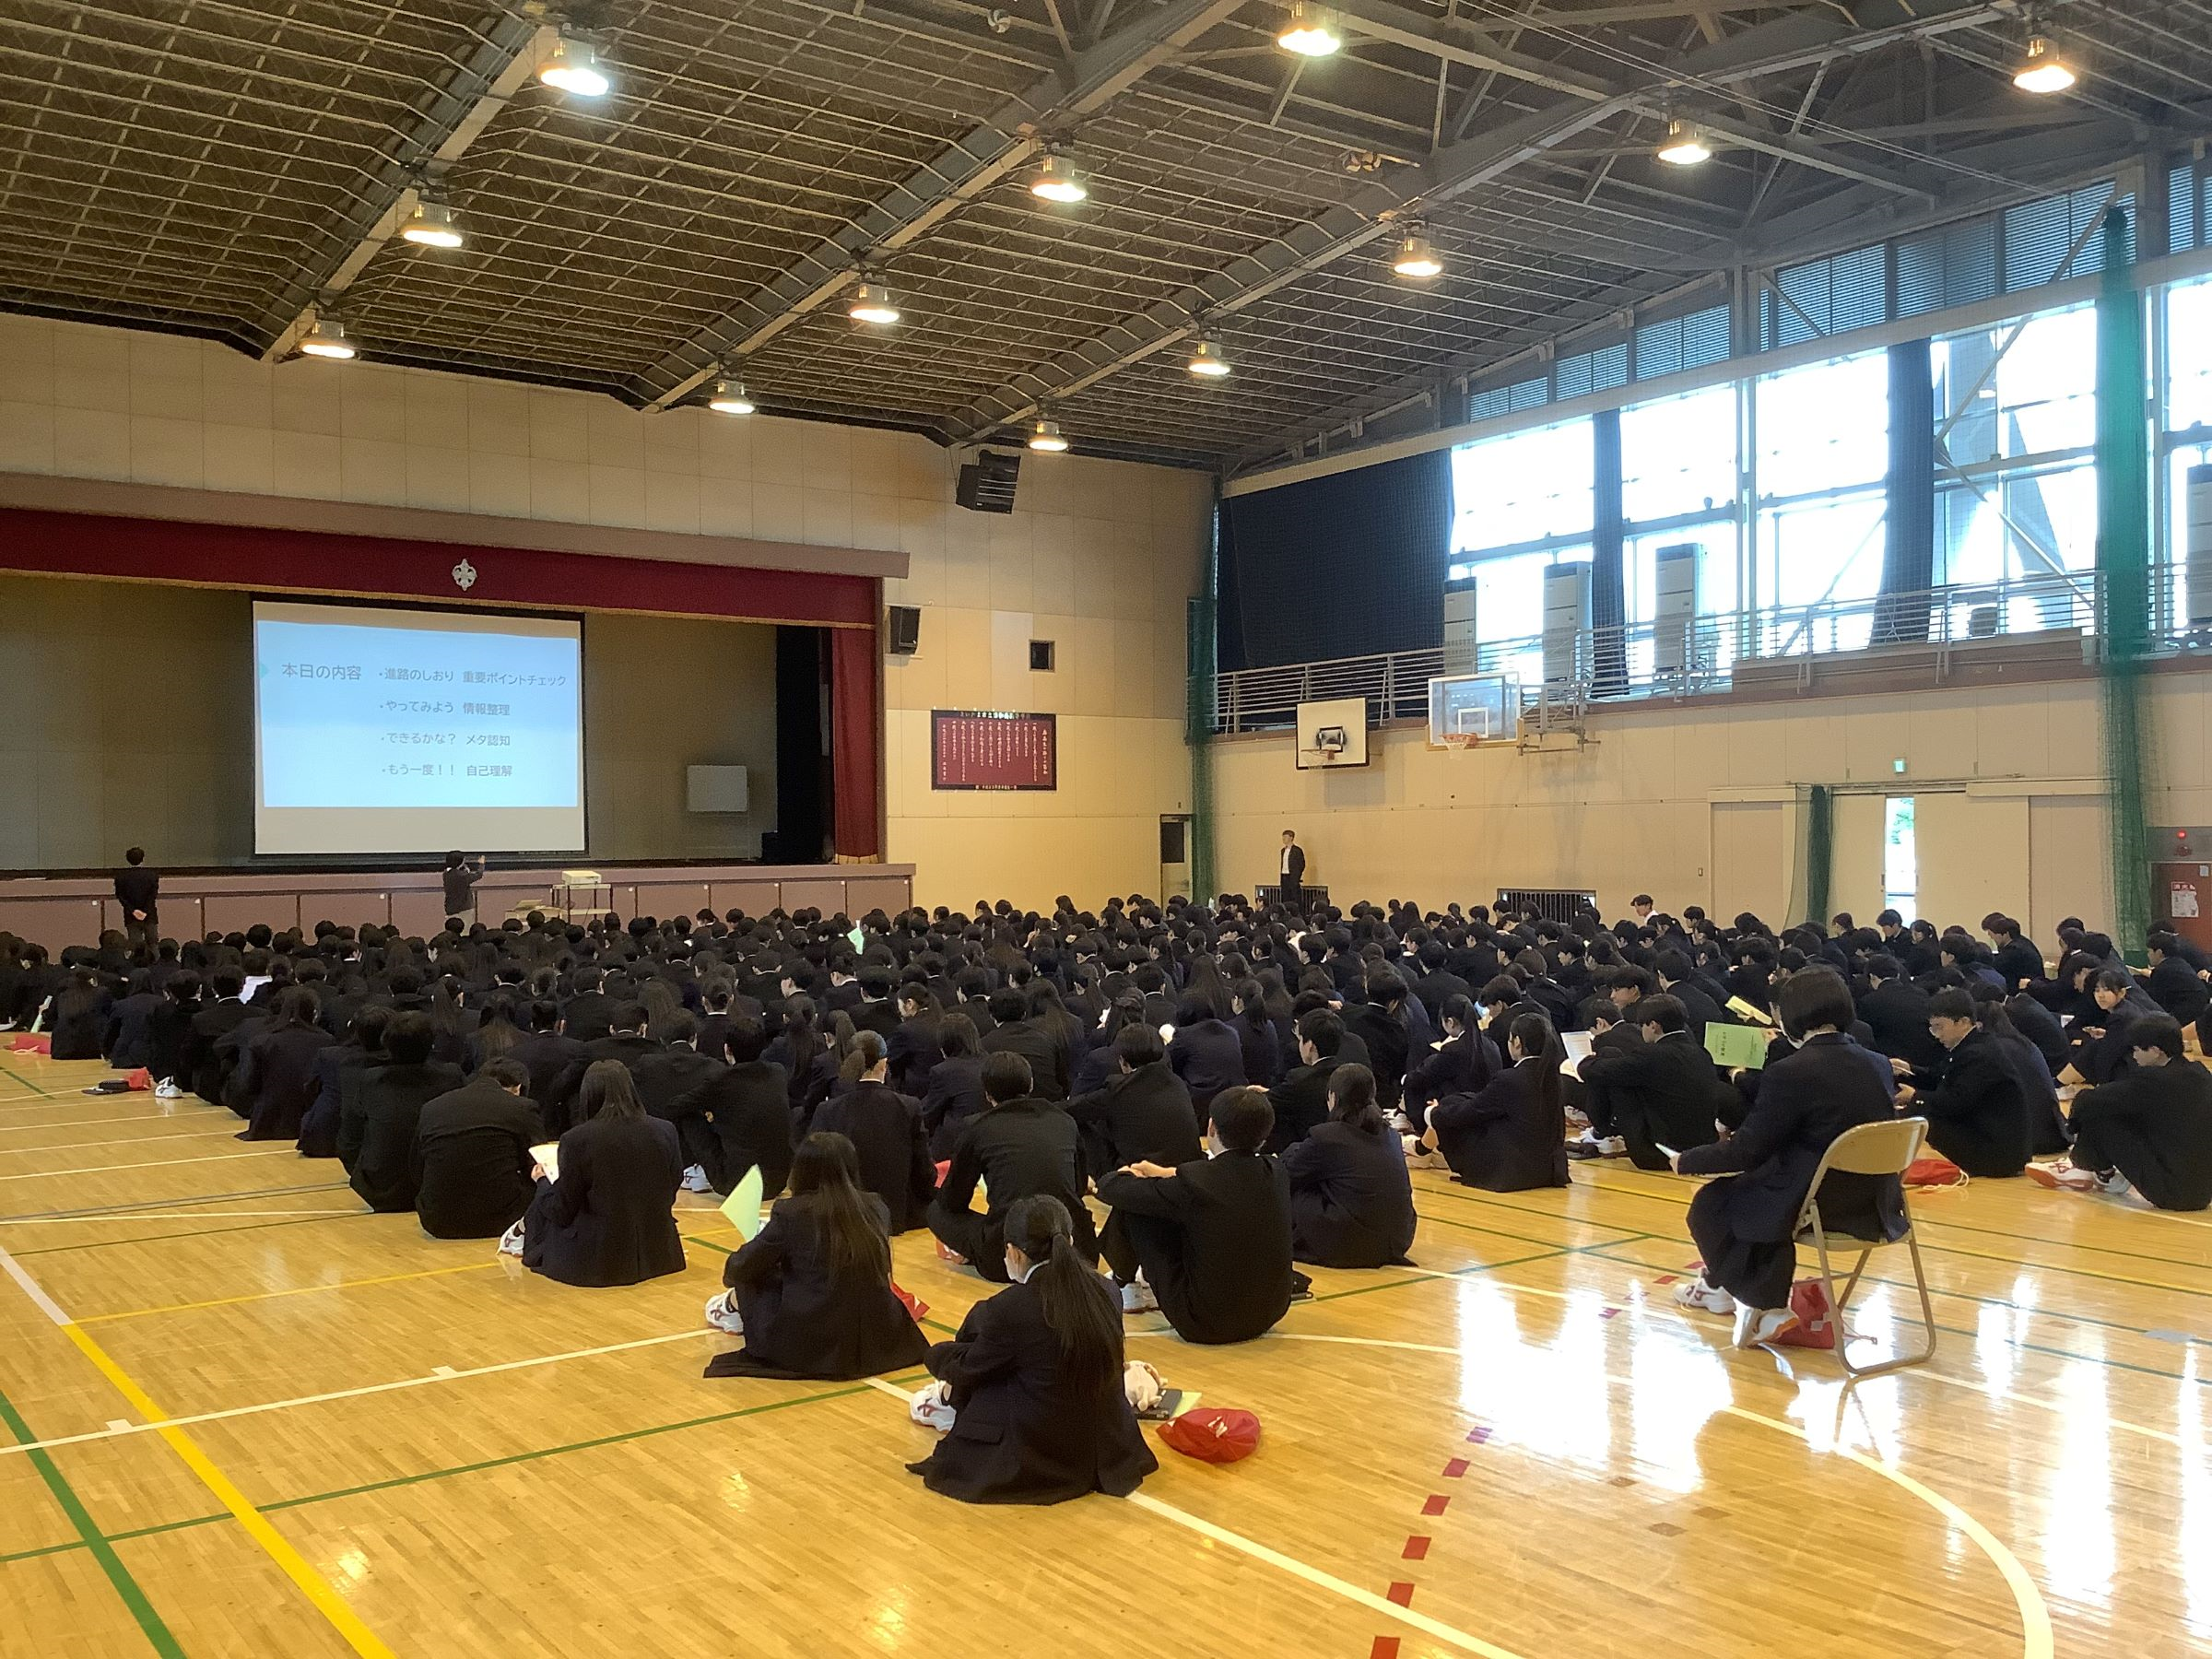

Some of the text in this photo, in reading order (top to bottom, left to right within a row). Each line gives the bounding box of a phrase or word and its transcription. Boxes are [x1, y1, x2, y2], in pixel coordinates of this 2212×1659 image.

[281, 662, 361, 680] 本日の内容
[463, 670, 566, 687] 重要ポイントチェック
[463, 701, 511, 716] 情報整理
[465, 735, 511, 746] メタ認知
[466, 765, 512, 777] 自己理解
